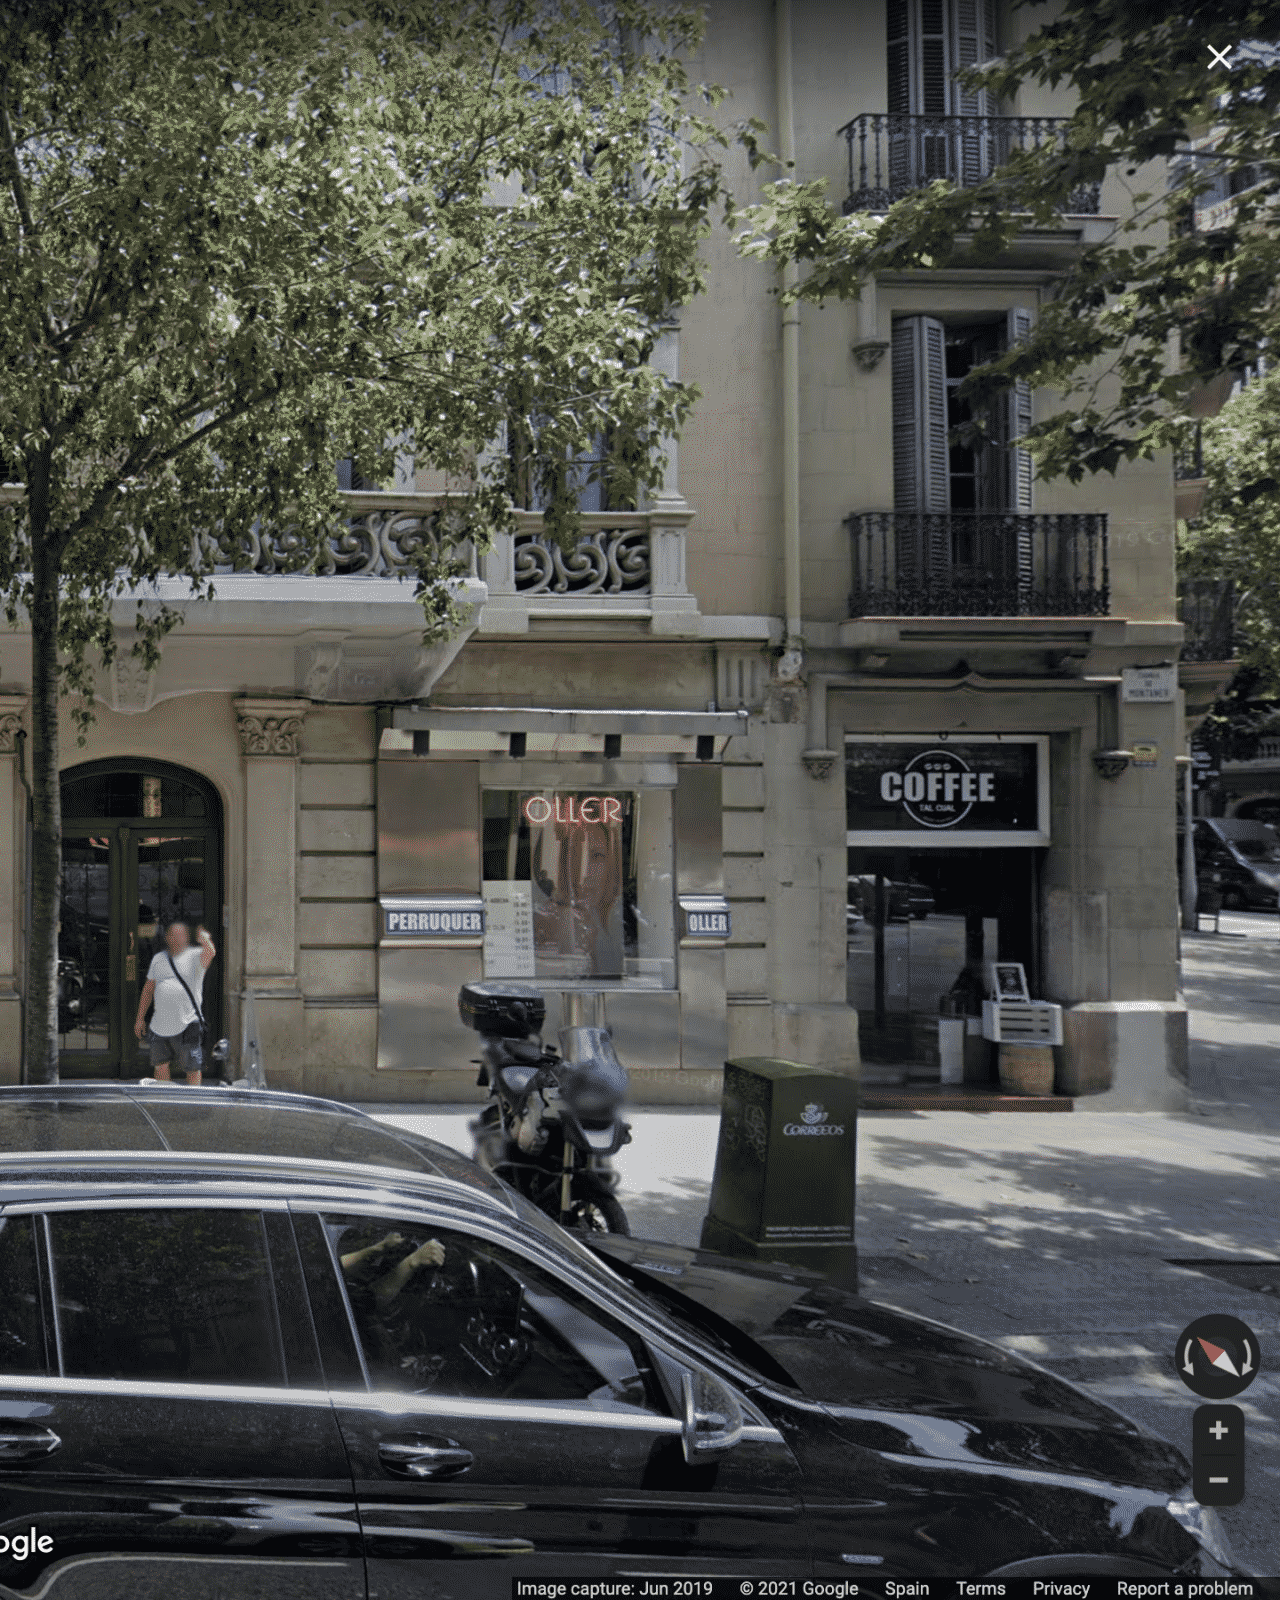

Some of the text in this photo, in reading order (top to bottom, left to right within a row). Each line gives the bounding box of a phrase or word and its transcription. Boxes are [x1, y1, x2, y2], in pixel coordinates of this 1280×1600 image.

[880, 771, 996, 802] COFFEE
[526, 796, 623, 823] OLLER
[919, 803, 956, 812] TAL CUAL
[389, 913, 481, 932] PERRUQUER
[689, 914, 728, 932] OLLER
